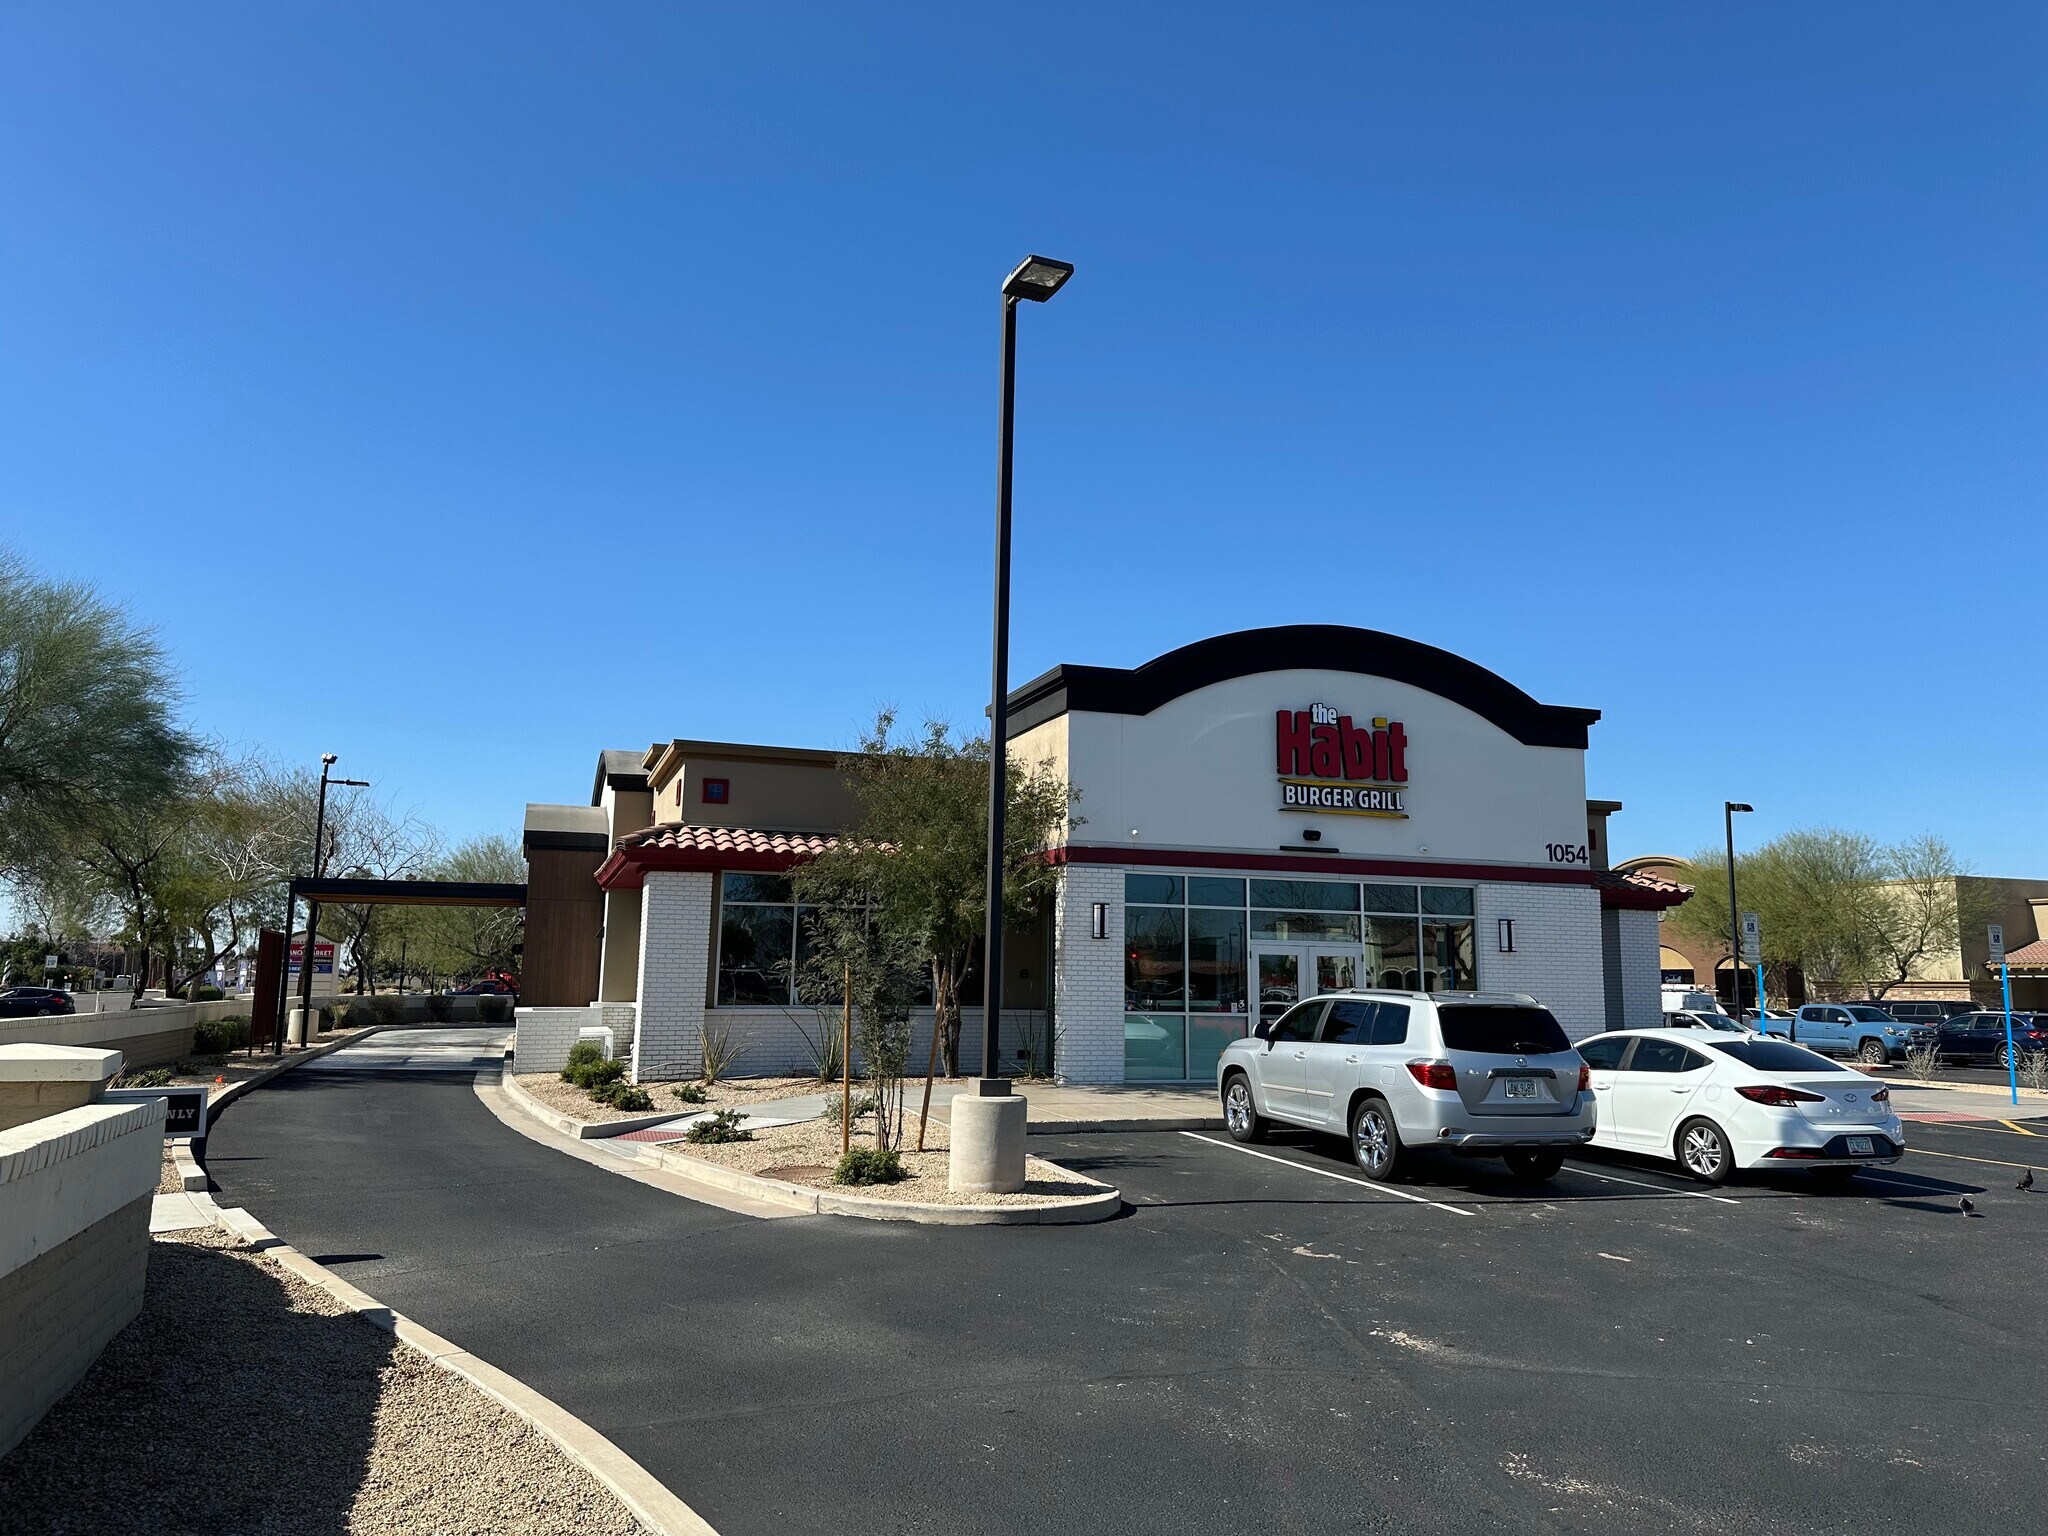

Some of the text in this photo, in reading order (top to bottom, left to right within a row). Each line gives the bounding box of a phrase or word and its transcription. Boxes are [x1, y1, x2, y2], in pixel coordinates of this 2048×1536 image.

[1310, 703, 1338, 724] the
[1276, 710, 1408, 782] Habit
[1284, 784, 1404, 810] BURGER GRILL
[1545, 843, 1588, 864] 1054
[166, 1108, 195, 1119] NLY
